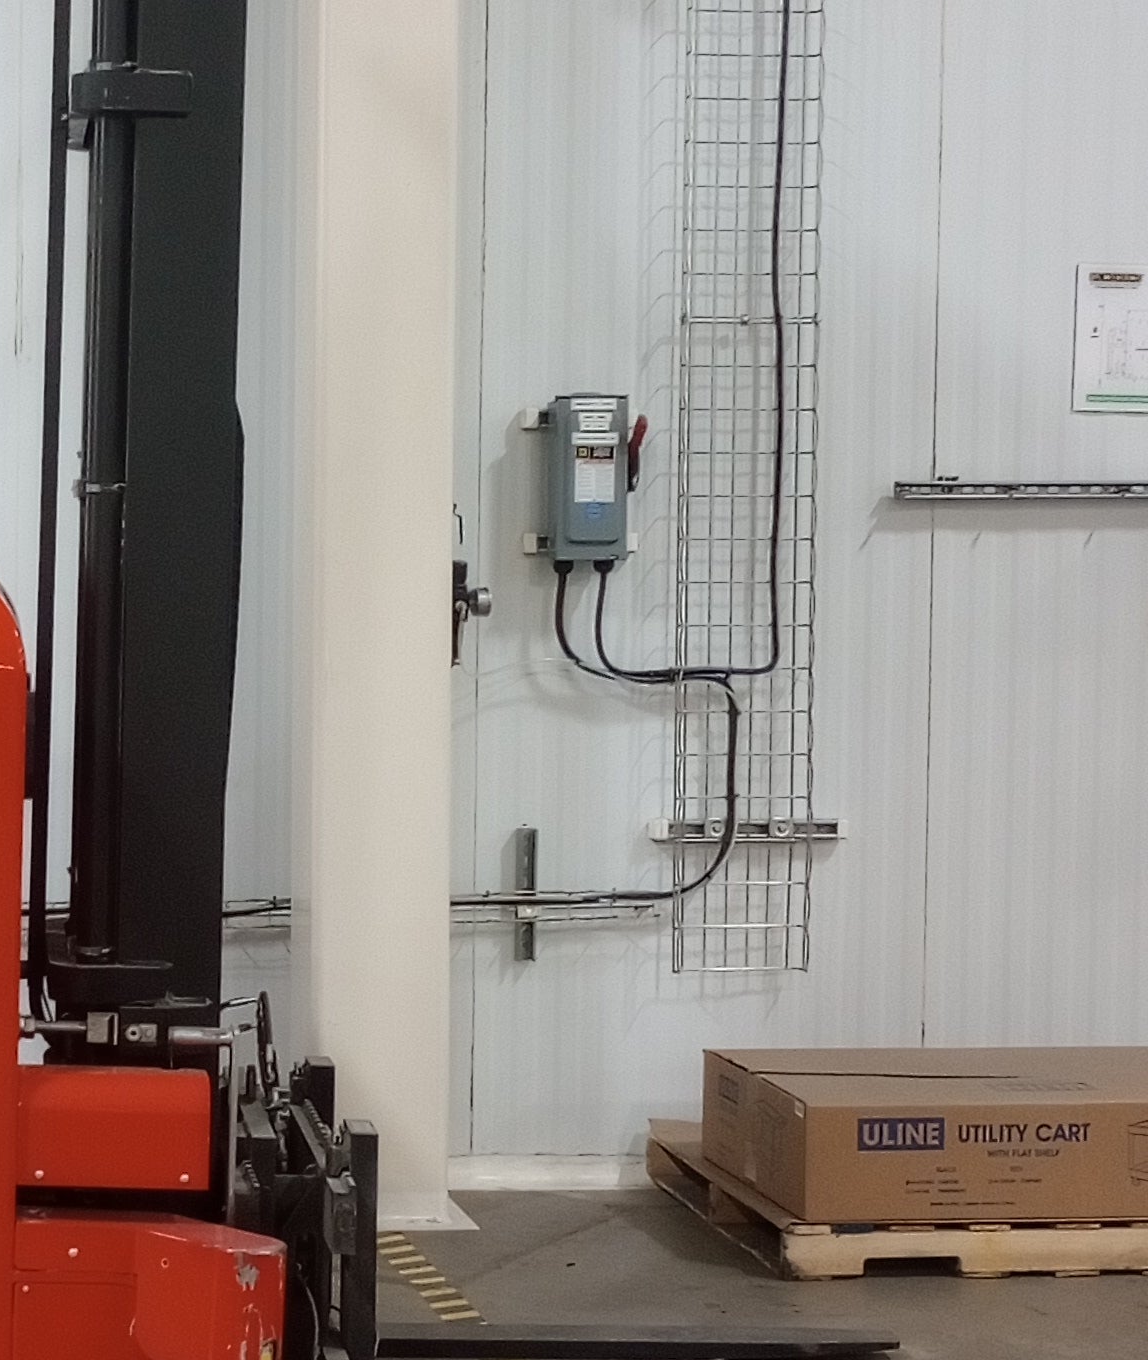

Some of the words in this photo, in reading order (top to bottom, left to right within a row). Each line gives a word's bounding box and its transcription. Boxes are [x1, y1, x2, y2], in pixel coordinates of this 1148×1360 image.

[862, 1122, 940, 1146] ULINE
[958, 1124, 1028, 1143] UTILITY
[1036, 1123, 1091, 1142] CART
[987, 1149, 1009, 1157] WITH
